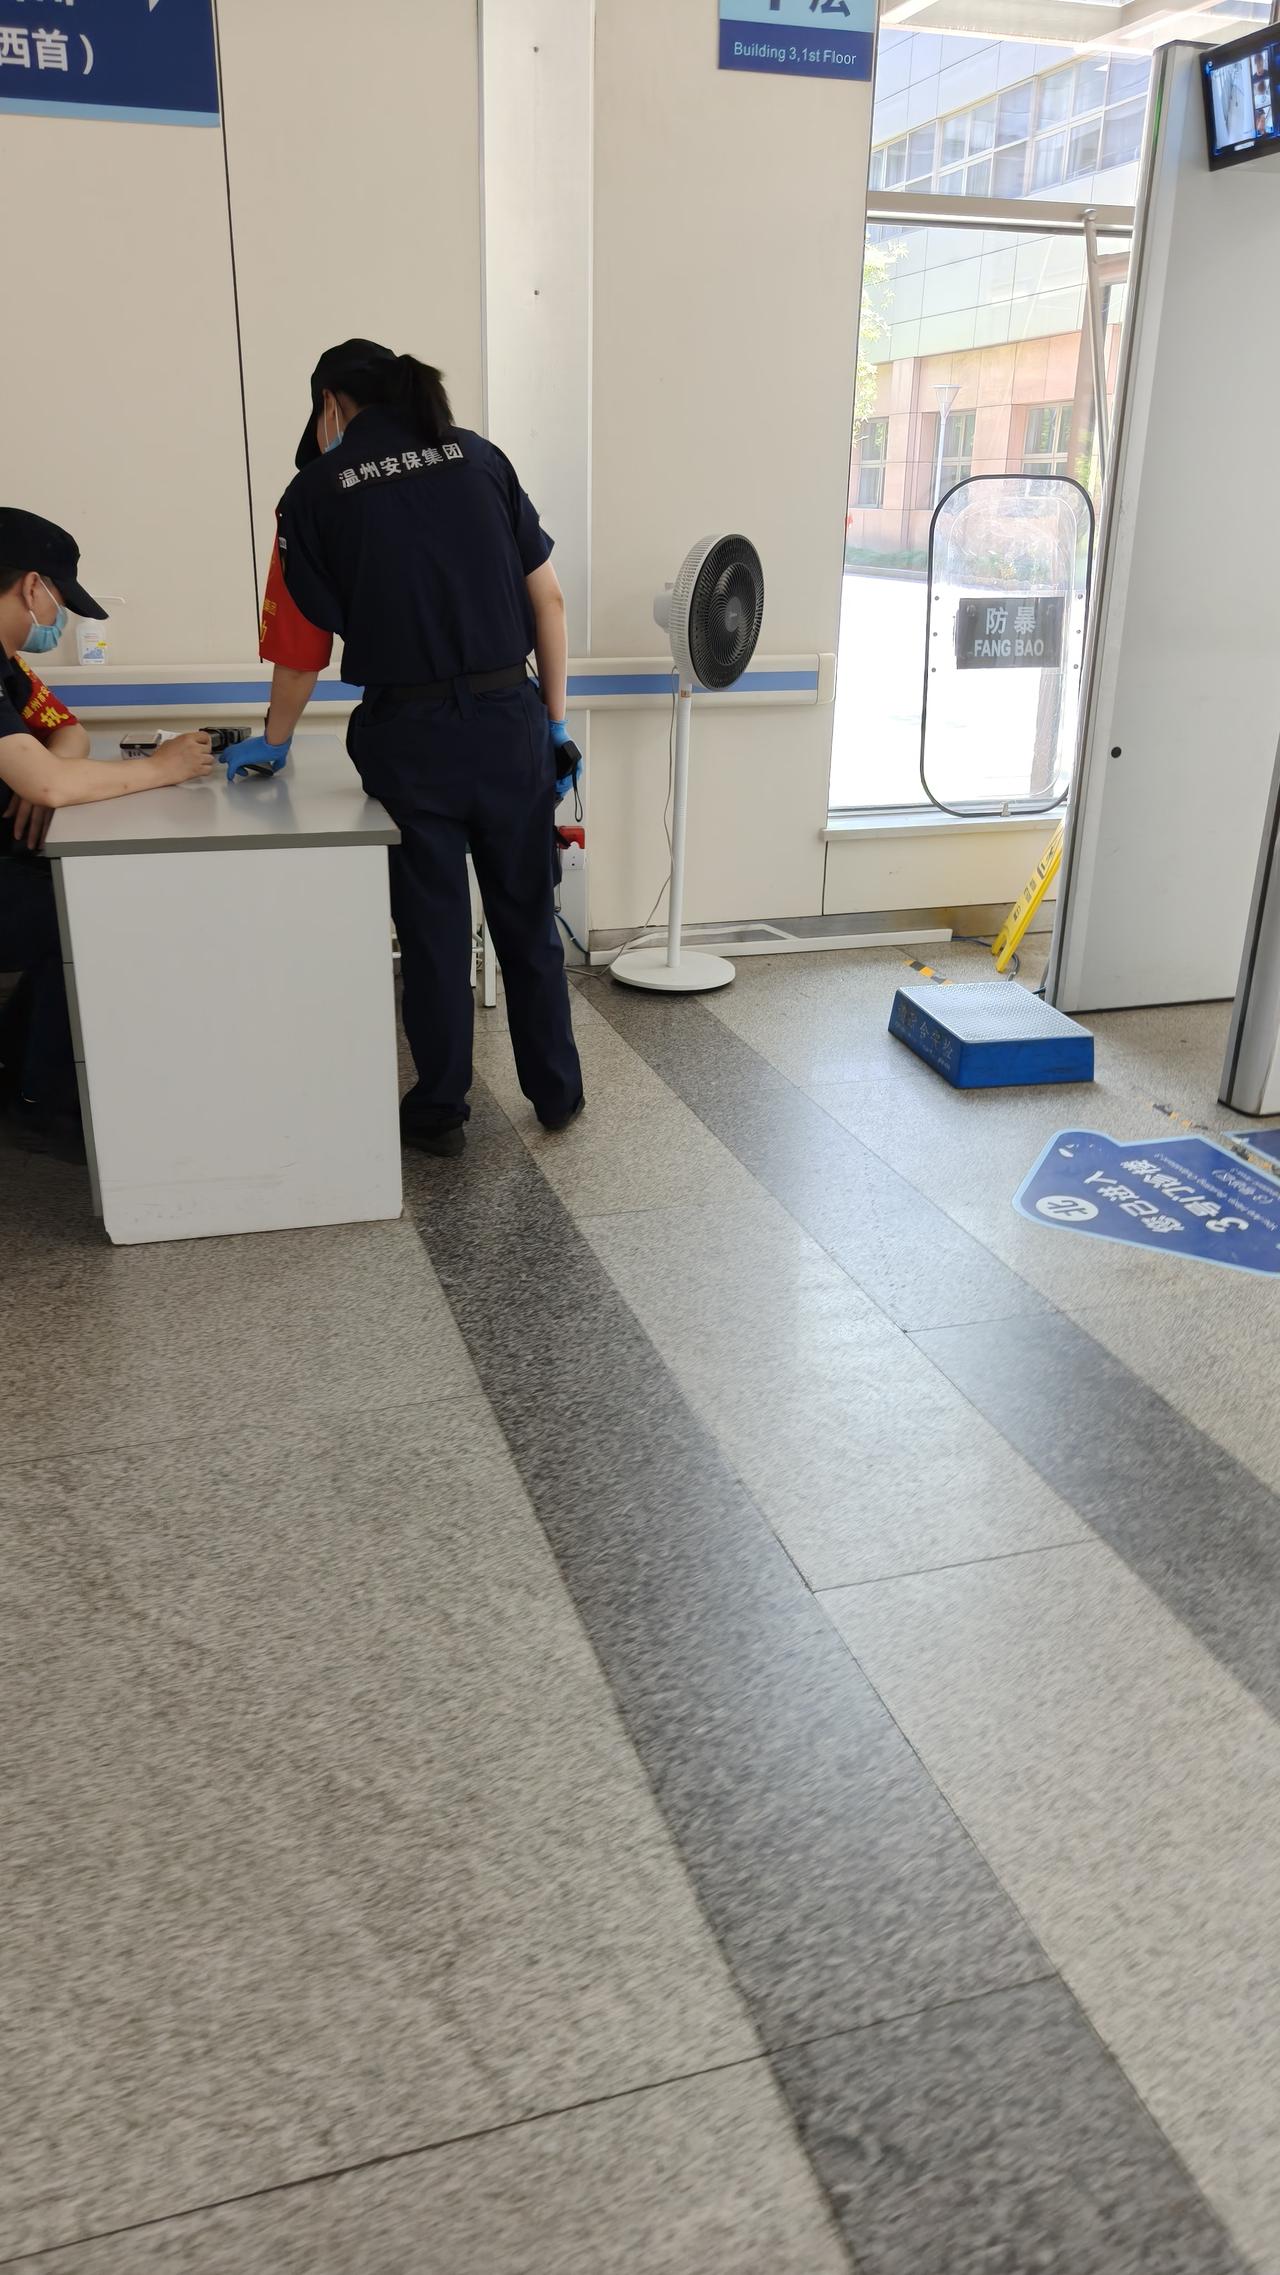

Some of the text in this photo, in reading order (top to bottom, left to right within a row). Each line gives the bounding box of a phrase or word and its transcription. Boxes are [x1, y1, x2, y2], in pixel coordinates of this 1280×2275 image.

[734, 41, 786, 62] Building
[823, 49, 857, 65] Floor
[338, 442, 464, 489] 温州安保集团
[986, 606, 1036, 635] 防暴
[974, 639, 1044, 657] FANG BAO
[1047, 1199, 1089, 1217] 北
[1083, 1170, 1185, 1233] 您已进入
[1120, 1158, 1249, 1233] 3号门诊楼
